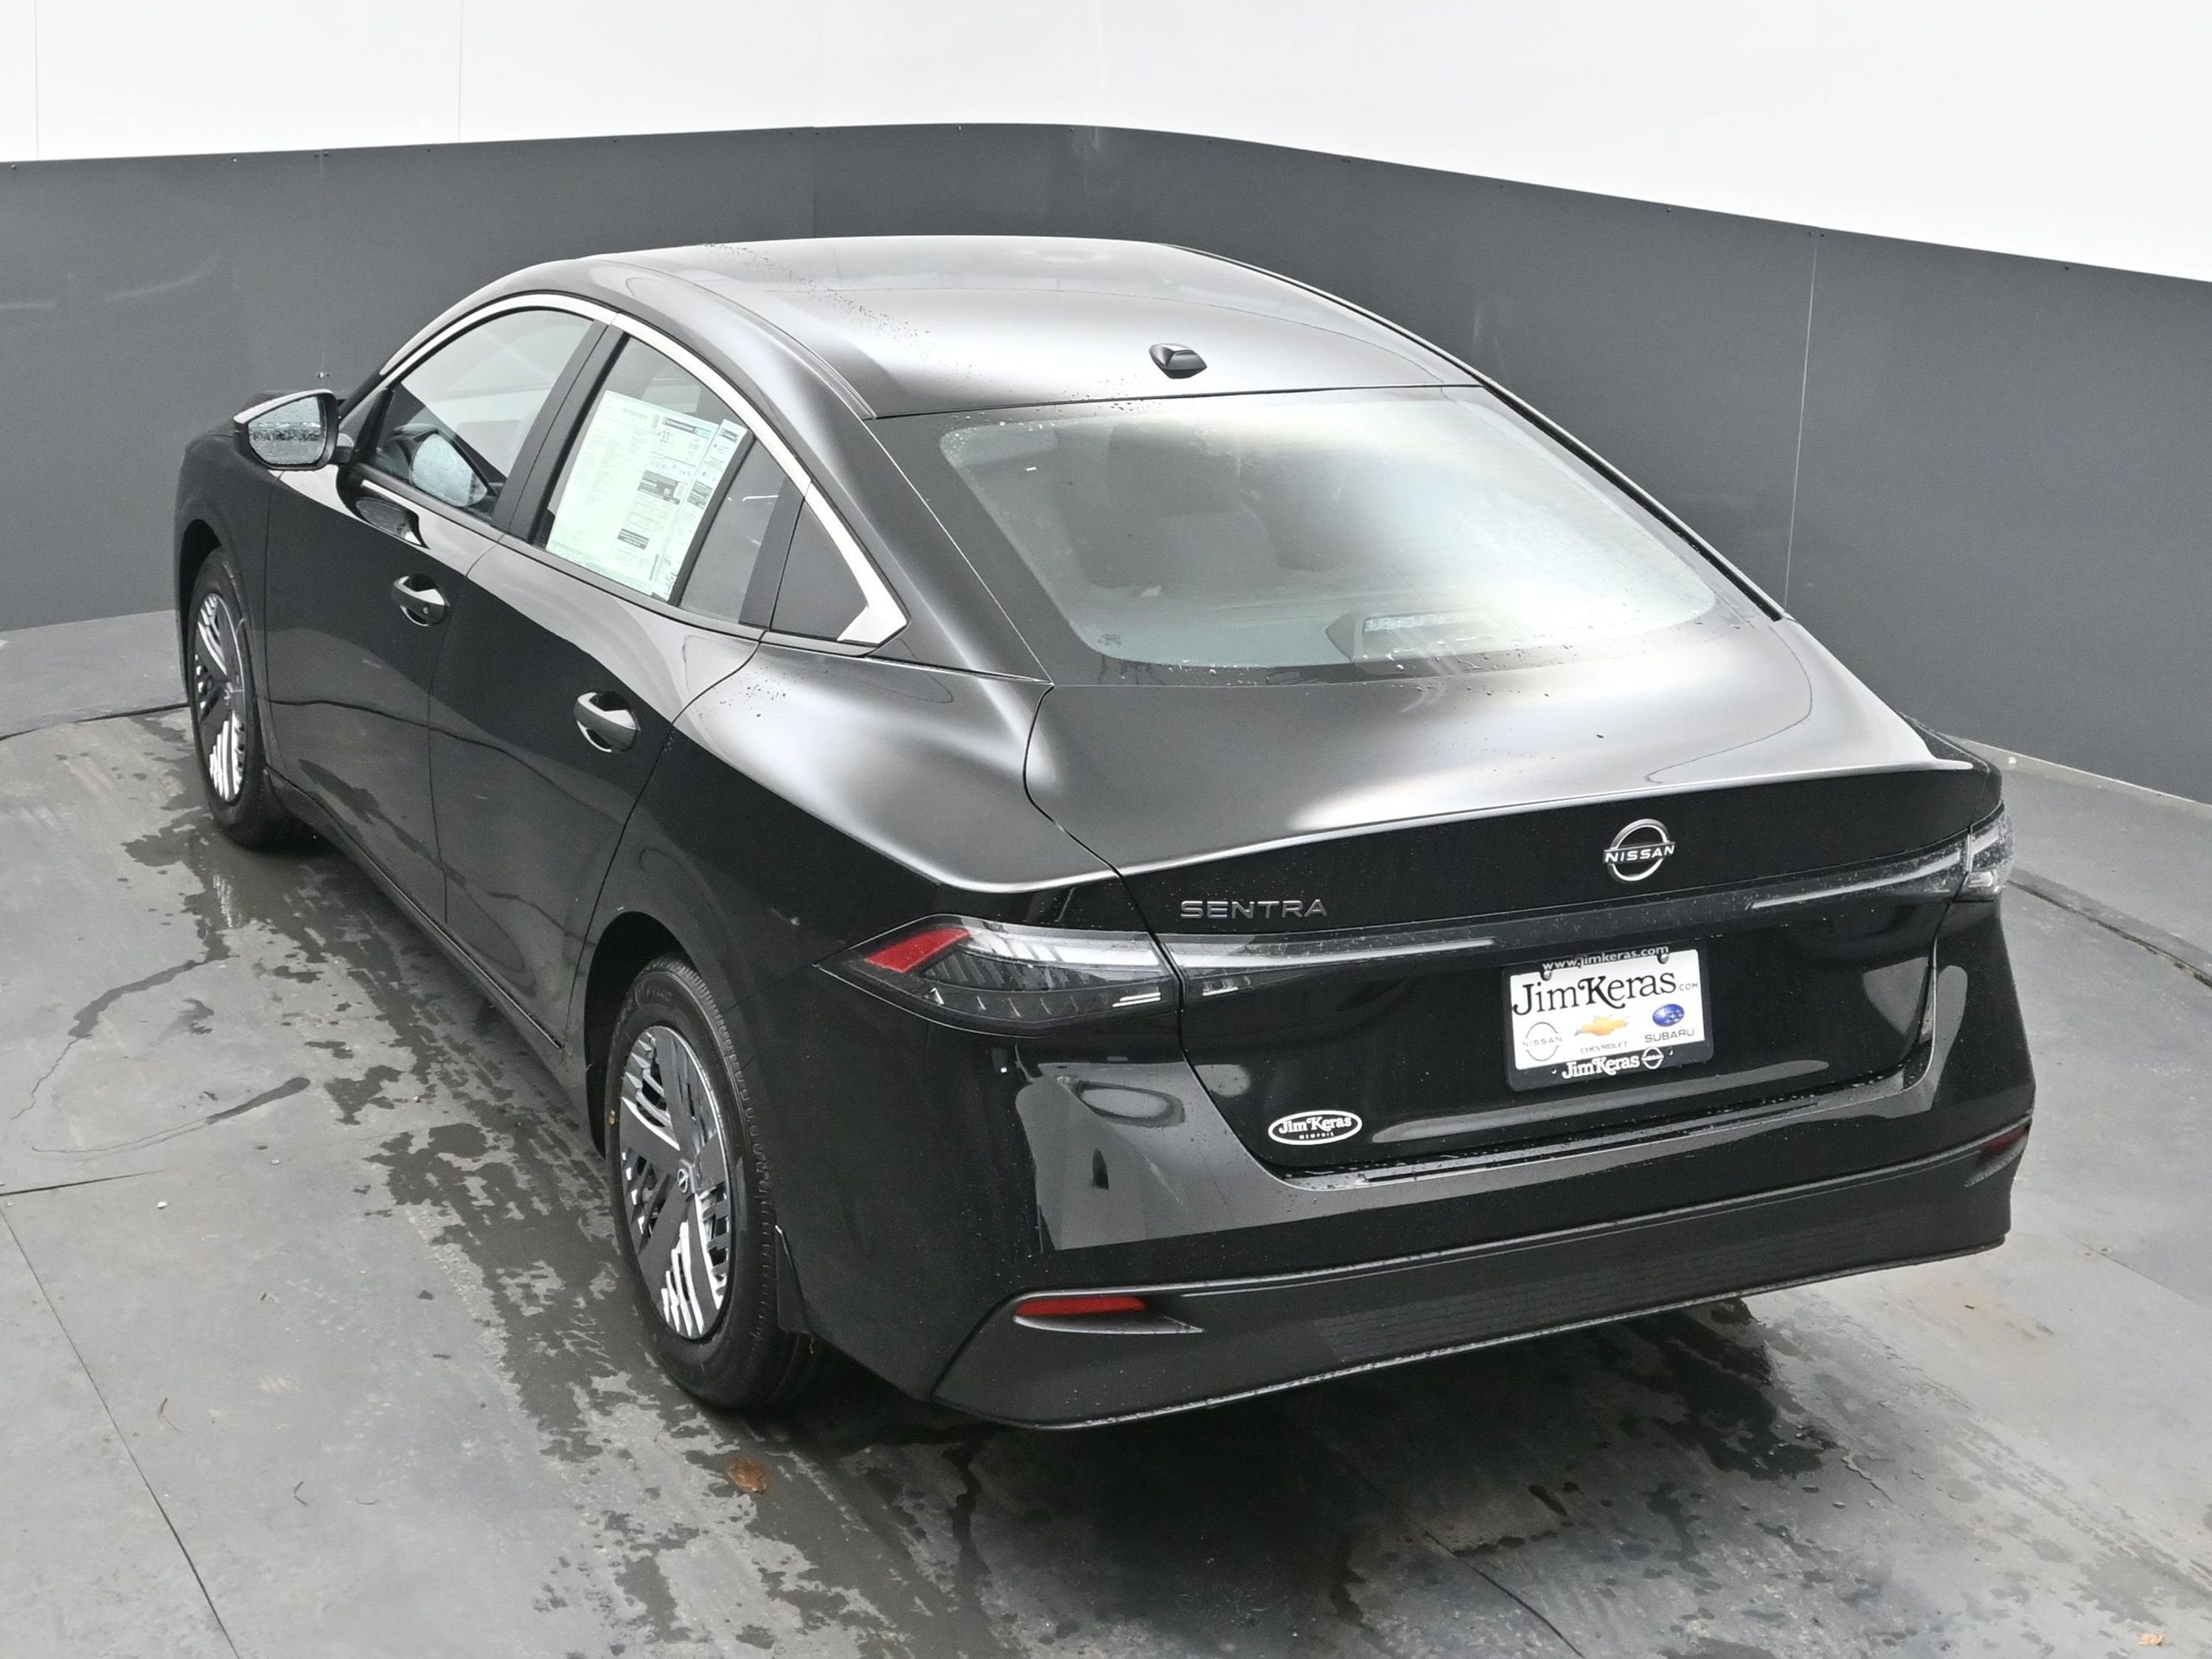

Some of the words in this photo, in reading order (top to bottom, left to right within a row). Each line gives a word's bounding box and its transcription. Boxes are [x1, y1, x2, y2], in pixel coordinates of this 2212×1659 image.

[1605, 844, 1675, 863] NISSAN
[1180, 899, 1327, 919] SENTRA
[1542, 945, 1669, 970] www.jimkeras.com
[1522, 1036, 1562, 1047] NISSAN
[1644, 1029, 1694, 1043] SUBARU
[1580, 1041, 1627, 1054] CHEVROLET
